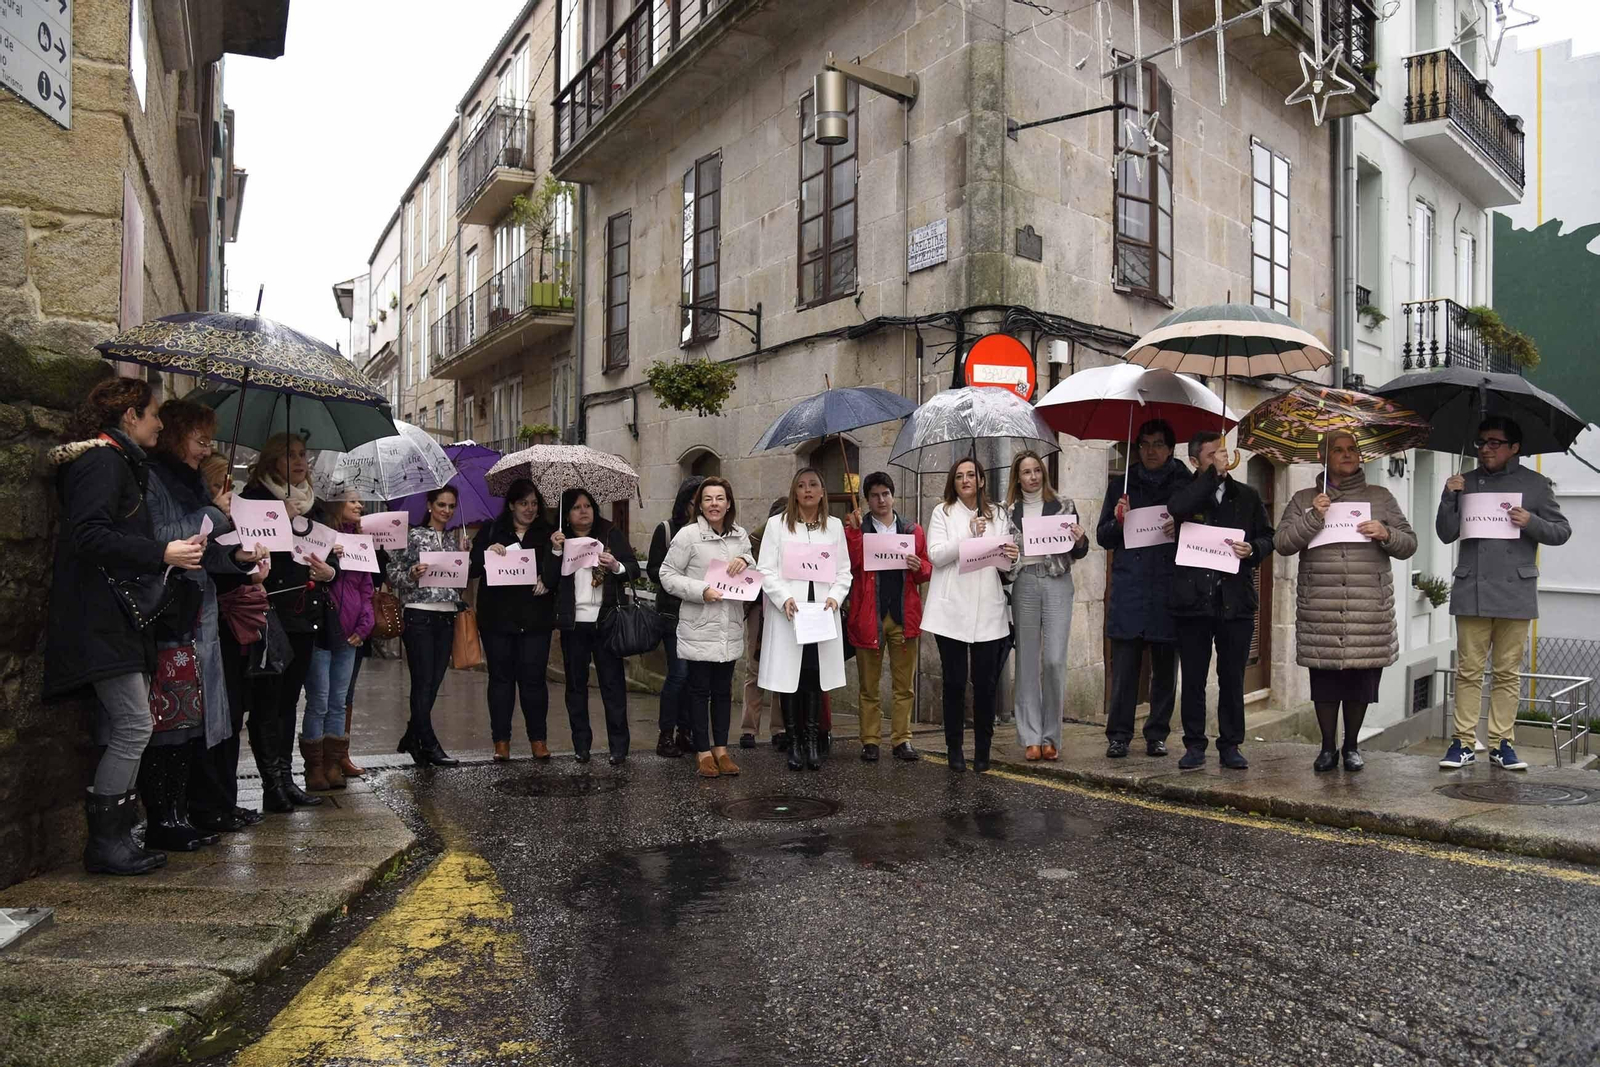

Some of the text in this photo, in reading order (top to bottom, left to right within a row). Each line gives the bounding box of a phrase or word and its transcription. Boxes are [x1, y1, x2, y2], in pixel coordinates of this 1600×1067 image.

[4, 36, 14, 52] de
[2, 69, 24, 92] Turismo
[340, 447, 421, 468] Singing in the
[240, 526, 277, 537] FLORI
[1029, 535, 1073, 545] LUCINDA
[1186, 543, 1208, 553] KARLA
[342, 551, 370, 562] ISABEL
[498, 568, 526, 576] PAQUI
[801, 562, 819, 571] ANA
[716, 581, 745, 594] LUCÍA
